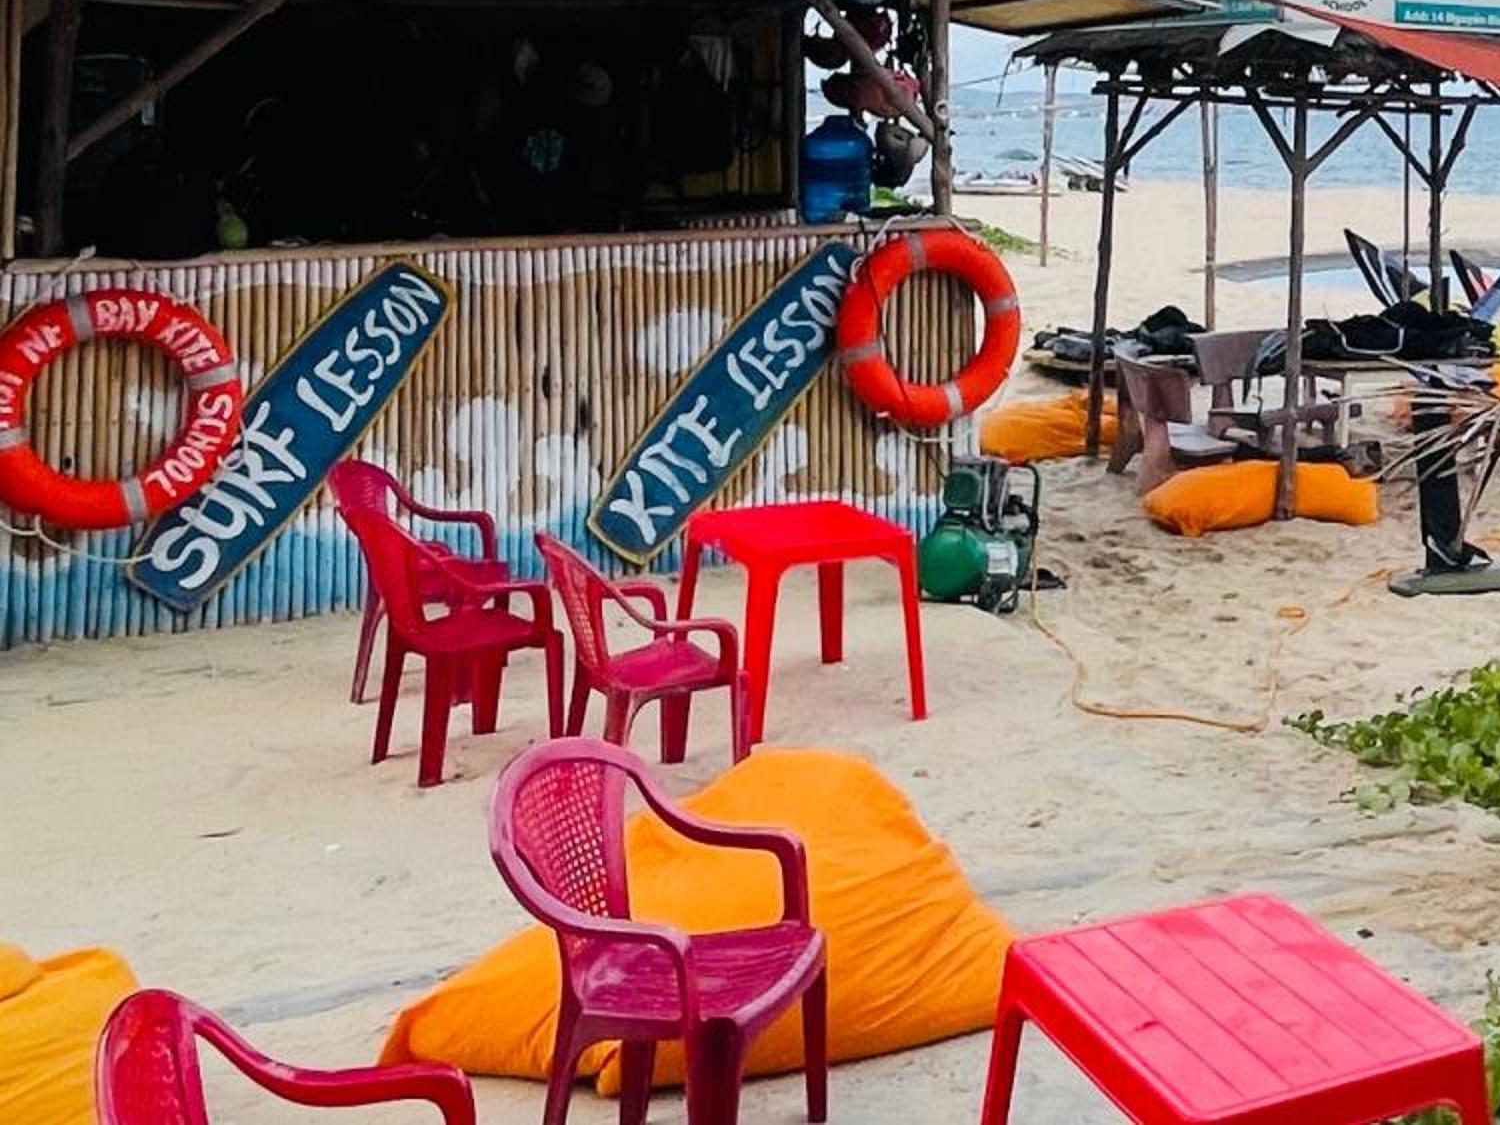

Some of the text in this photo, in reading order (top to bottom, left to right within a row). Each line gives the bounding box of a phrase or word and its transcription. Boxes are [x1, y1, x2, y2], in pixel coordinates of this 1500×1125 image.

[16, 323, 62, 365] NE
[95, 296, 160, 333] BAY
[155, 316, 221, 374] KITE
[151, 271, 441, 590] SURF LESSON
[609, 254, 849, 545] KITE LESSON
[144, 392, 234, 499] SCHOOL
